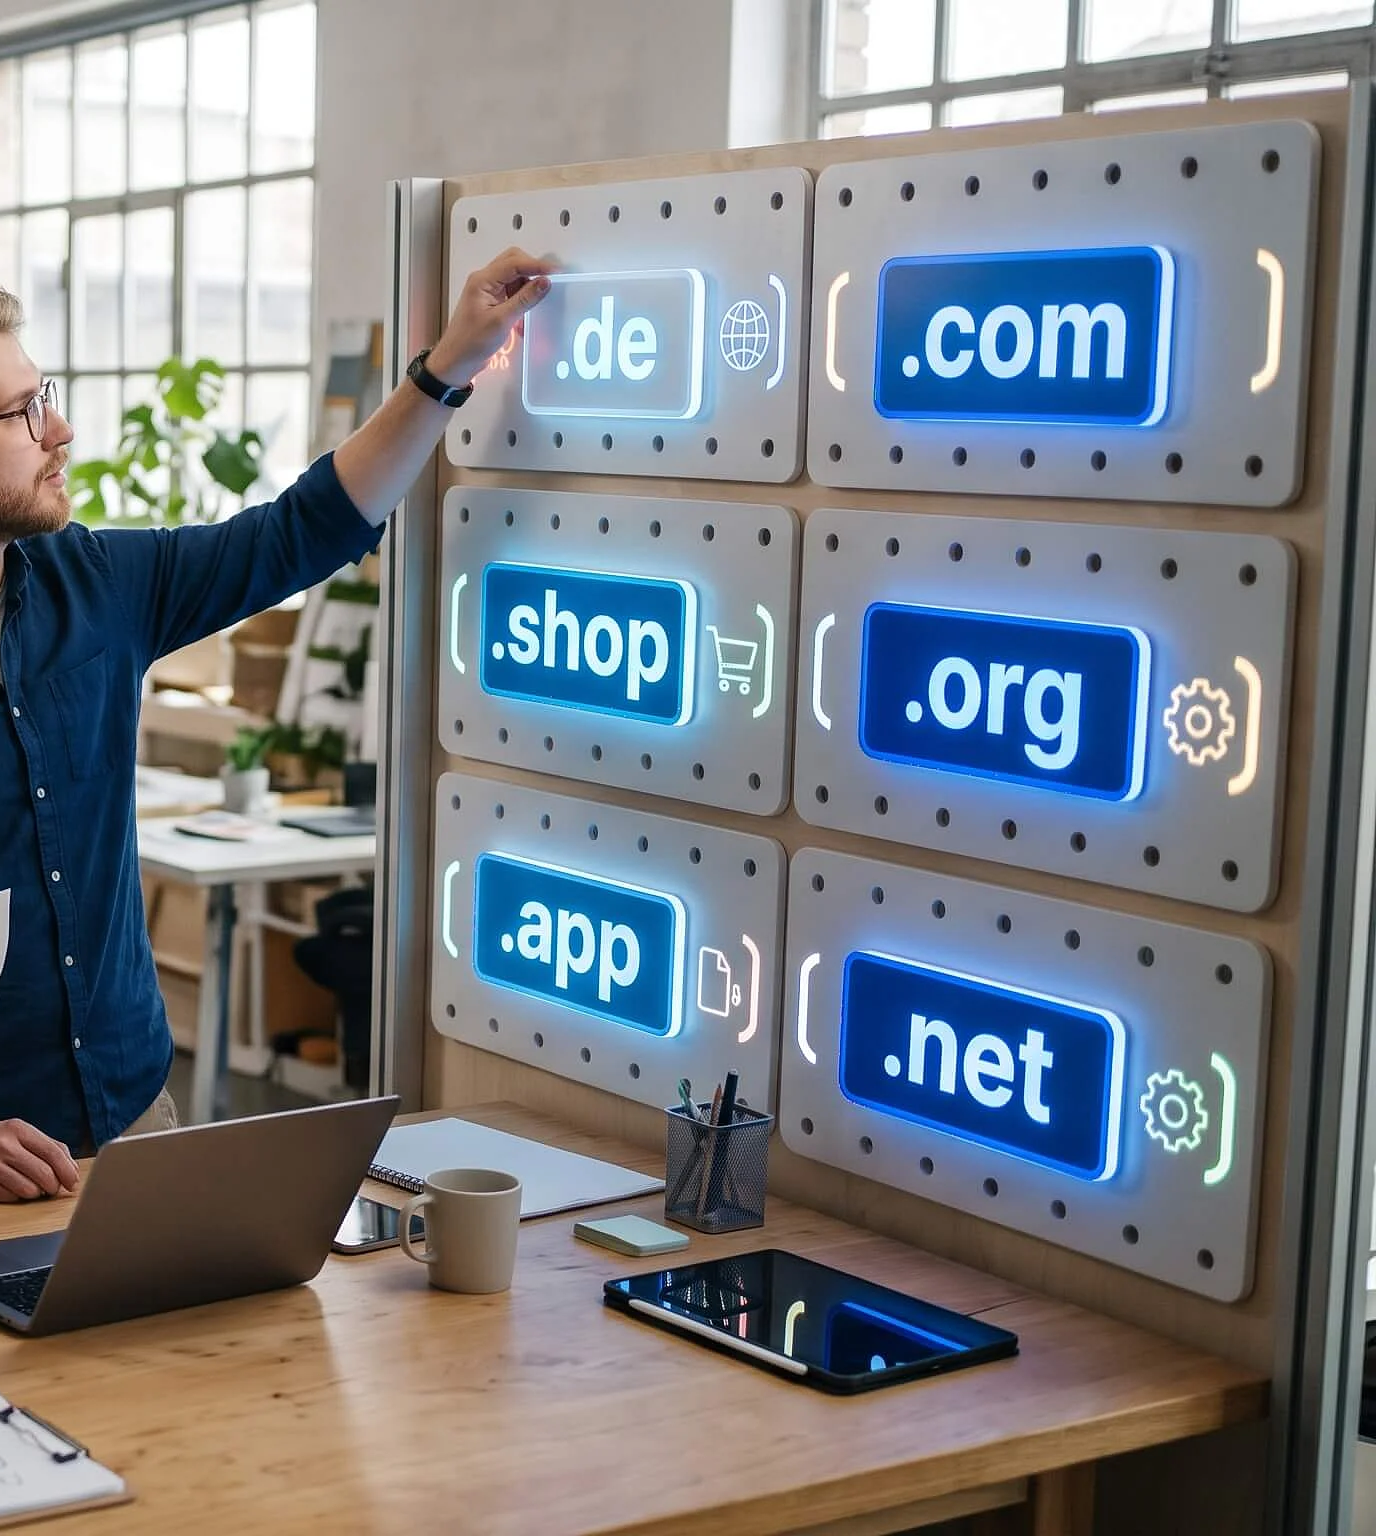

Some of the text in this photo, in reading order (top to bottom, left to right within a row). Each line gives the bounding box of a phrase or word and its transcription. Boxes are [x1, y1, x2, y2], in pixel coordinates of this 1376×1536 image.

[557, 295, 657, 380] .de
[902, 303, 1127, 378] .com
[492, 589, 669, 701] .shop
[906, 657, 1082, 770] .org
[501, 901, 640, 1003] .app
[884, 1013, 1054, 1123] .net
